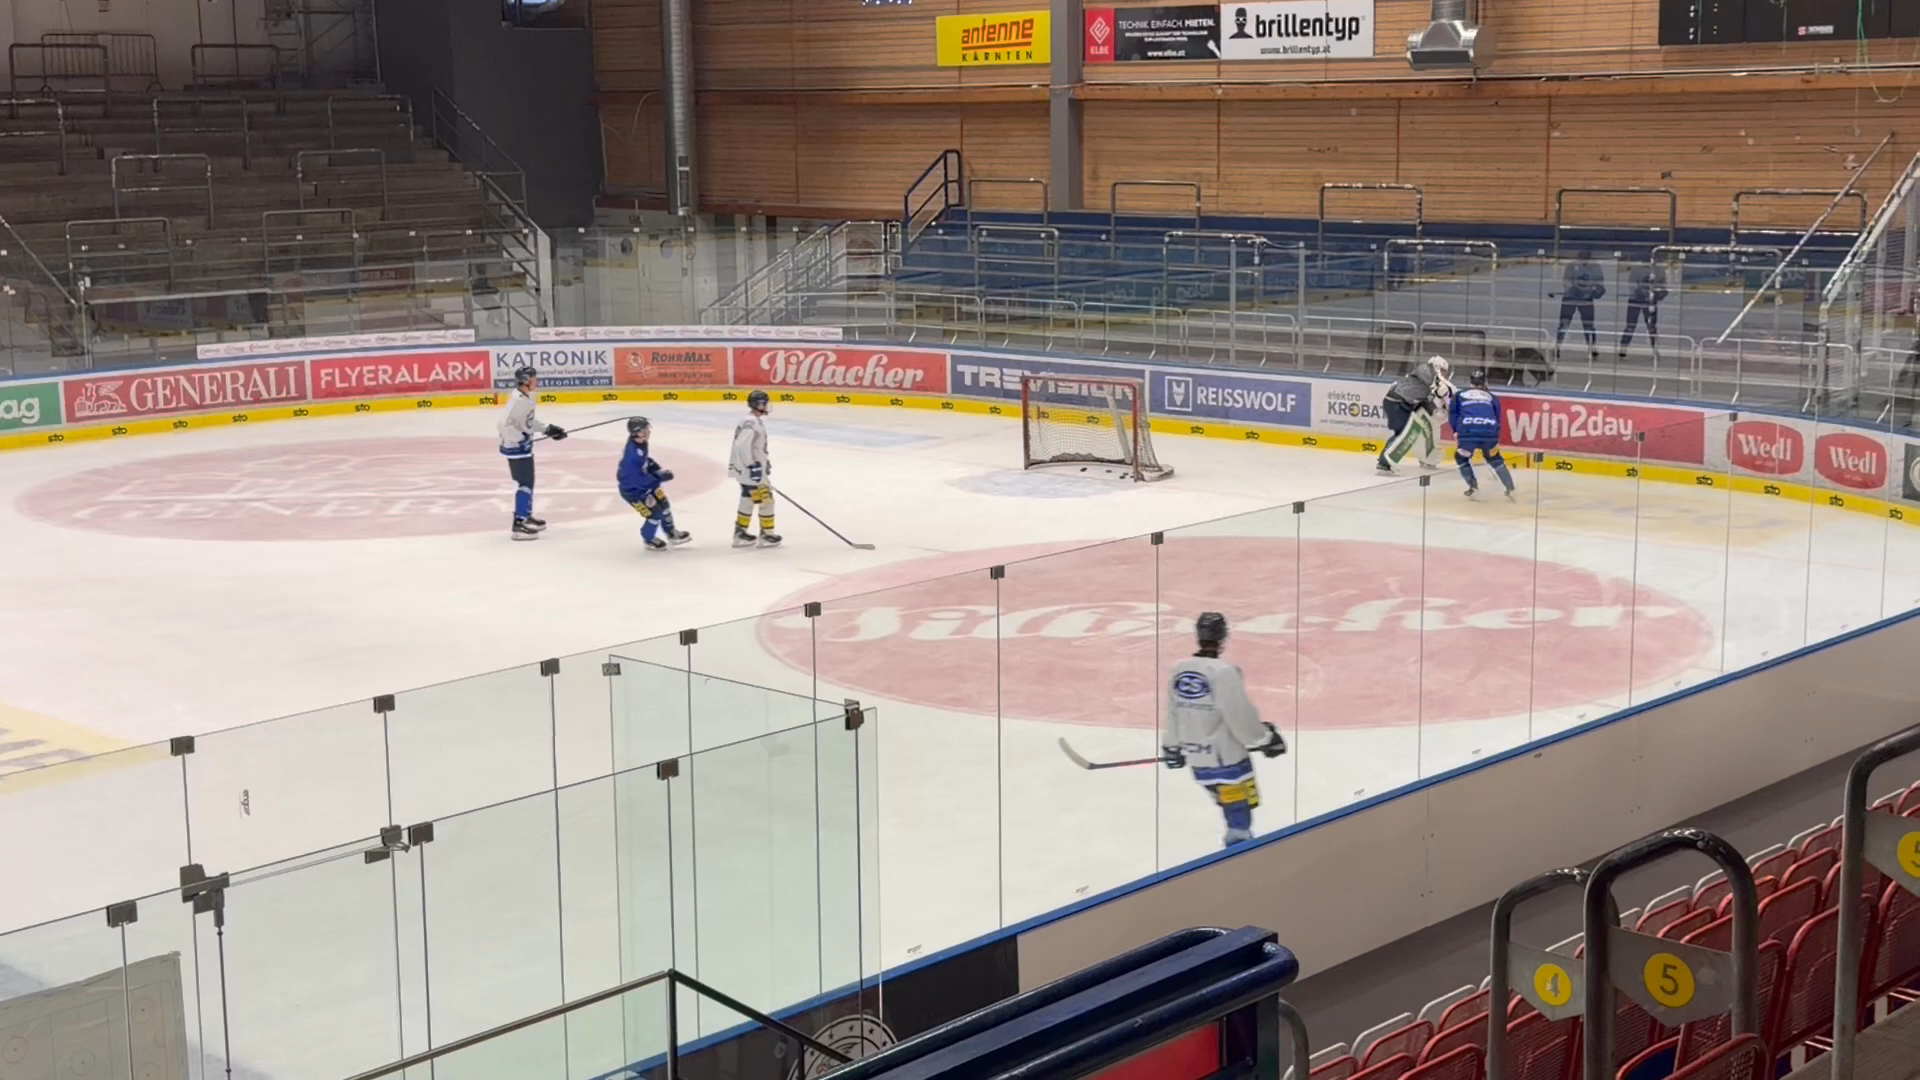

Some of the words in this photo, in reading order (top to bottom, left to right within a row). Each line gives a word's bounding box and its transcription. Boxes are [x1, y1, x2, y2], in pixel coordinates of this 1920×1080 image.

[962, 18, 1034, 44] antenne
[1255, 12, 1360, 41] brillentyp
[1260, 45, 1331, 55] www.brillentyp.at
[496, 350, 607, 368] KATRONIK
[760, 350, 924, 389] Villacher
[320, 361, 485, 389] FLYERALARM
[129, 366, 299, 412] GENERALI
[479, 396, 494, 405] sto
[541, 394, 556, 403] sto
[602, 392, 618, 402] sto
[663, 392, 678, 401] sto
[722, 392, 737, 401] sto
[780, 393, 794, 402] sto
[836, 395, 850, 404] sto
[1197, 386, 1296, 413] REISSWOLF
[1327, 390, 1360, 402] elektro
[417, 399, 432, 408] sto
[890, 397, 903, 406] sto
[941, 401, 954, 410] sto
[293, 408, 308, 417] sto
[355, 403, 370, 412] sto
[989, 405, 1001, 415] sto
[232, 413, 248, 422] sto
[1506, 402, 1633, 443] win2day
[173, 420, 188, 429] sto
[111, 426, 128, 436] sto
[1190, 425, 1204, 435] sto
[1245, 430, 1260, 440] sto
[48, 434, 64, 443] sto
[1302, 436, 1317, 446] sto
[1362, 442, 1377, 452] sto
[1737, 433, 1792, 461] Wedl
[1555, 459, 1573, 471] sto
[1828, 445, 1877, 475] Wedl
[1696, 474, 1713, 486] sto
[1764, 484, 1781, 496] sto
[1829, 495, 1844, 507] sto
[1889, 507, 1903, 520] sto
[1545, 972, 1561, 997] 4
[1659, 963, 1679, 996] 5
